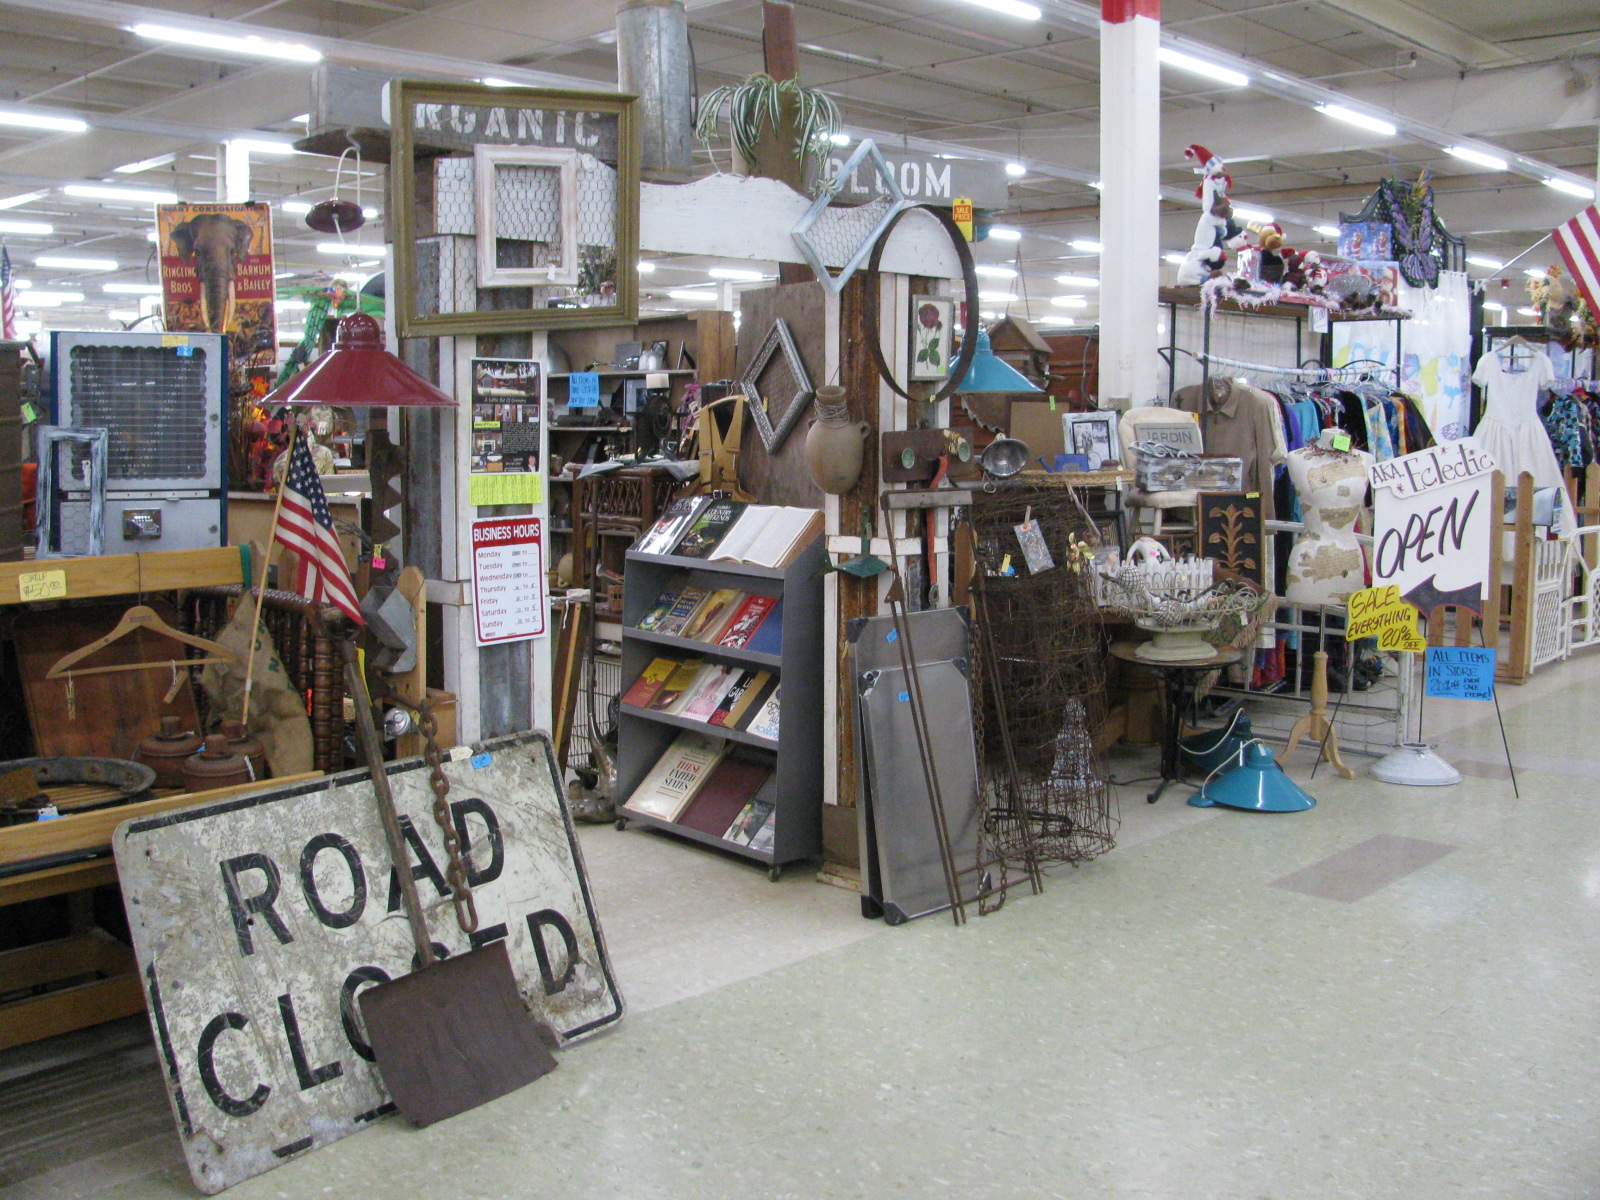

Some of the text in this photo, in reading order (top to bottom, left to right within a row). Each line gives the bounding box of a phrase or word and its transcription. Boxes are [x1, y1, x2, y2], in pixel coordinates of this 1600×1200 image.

[956, 206, 969, 214] SALE
[954, 213, 971, 221] PRICE
[162, 265, 197, 278] RINGLING
[237, 264, 271, 276] BARNUM
[170, 281, 193, 293] BROS
[243, 279, 271, 291] BAILEY
[1147, 431, 1192, 444] JARDIN
[1403, 443, 1494, 493] Eclectic
[473, 523, 540, 542] BUSINESS HOURS
[1375, 489, 1480, 579] OPEN
[478, 550, 502, 559] Monday
[479, 562, 504, 570] Tuesday
[479, 573, 512, 582] Wednesday
[480, 585, 507, 594] Thursday
[480, 598, 498, 606] Friday
[1351, 584, 1396, 619] SALE
[481, 608, 508, 617] Saturday
[482, 621, 504, 629] Sunday
[1347, 608, 1411, 639] EVERYTHING
[1382, 625, 1412, 648] 20%
[1432, 649, 1490, 664] ALL ITEMS
[1428, 664, 1478, 677] IN STORE
[1430, 678, 1451, 692] 20%
[668, 768, 697, 782] UNITED
[664, 777, 689, 790] STATES
[220, 798, 505, 956] ROAD
